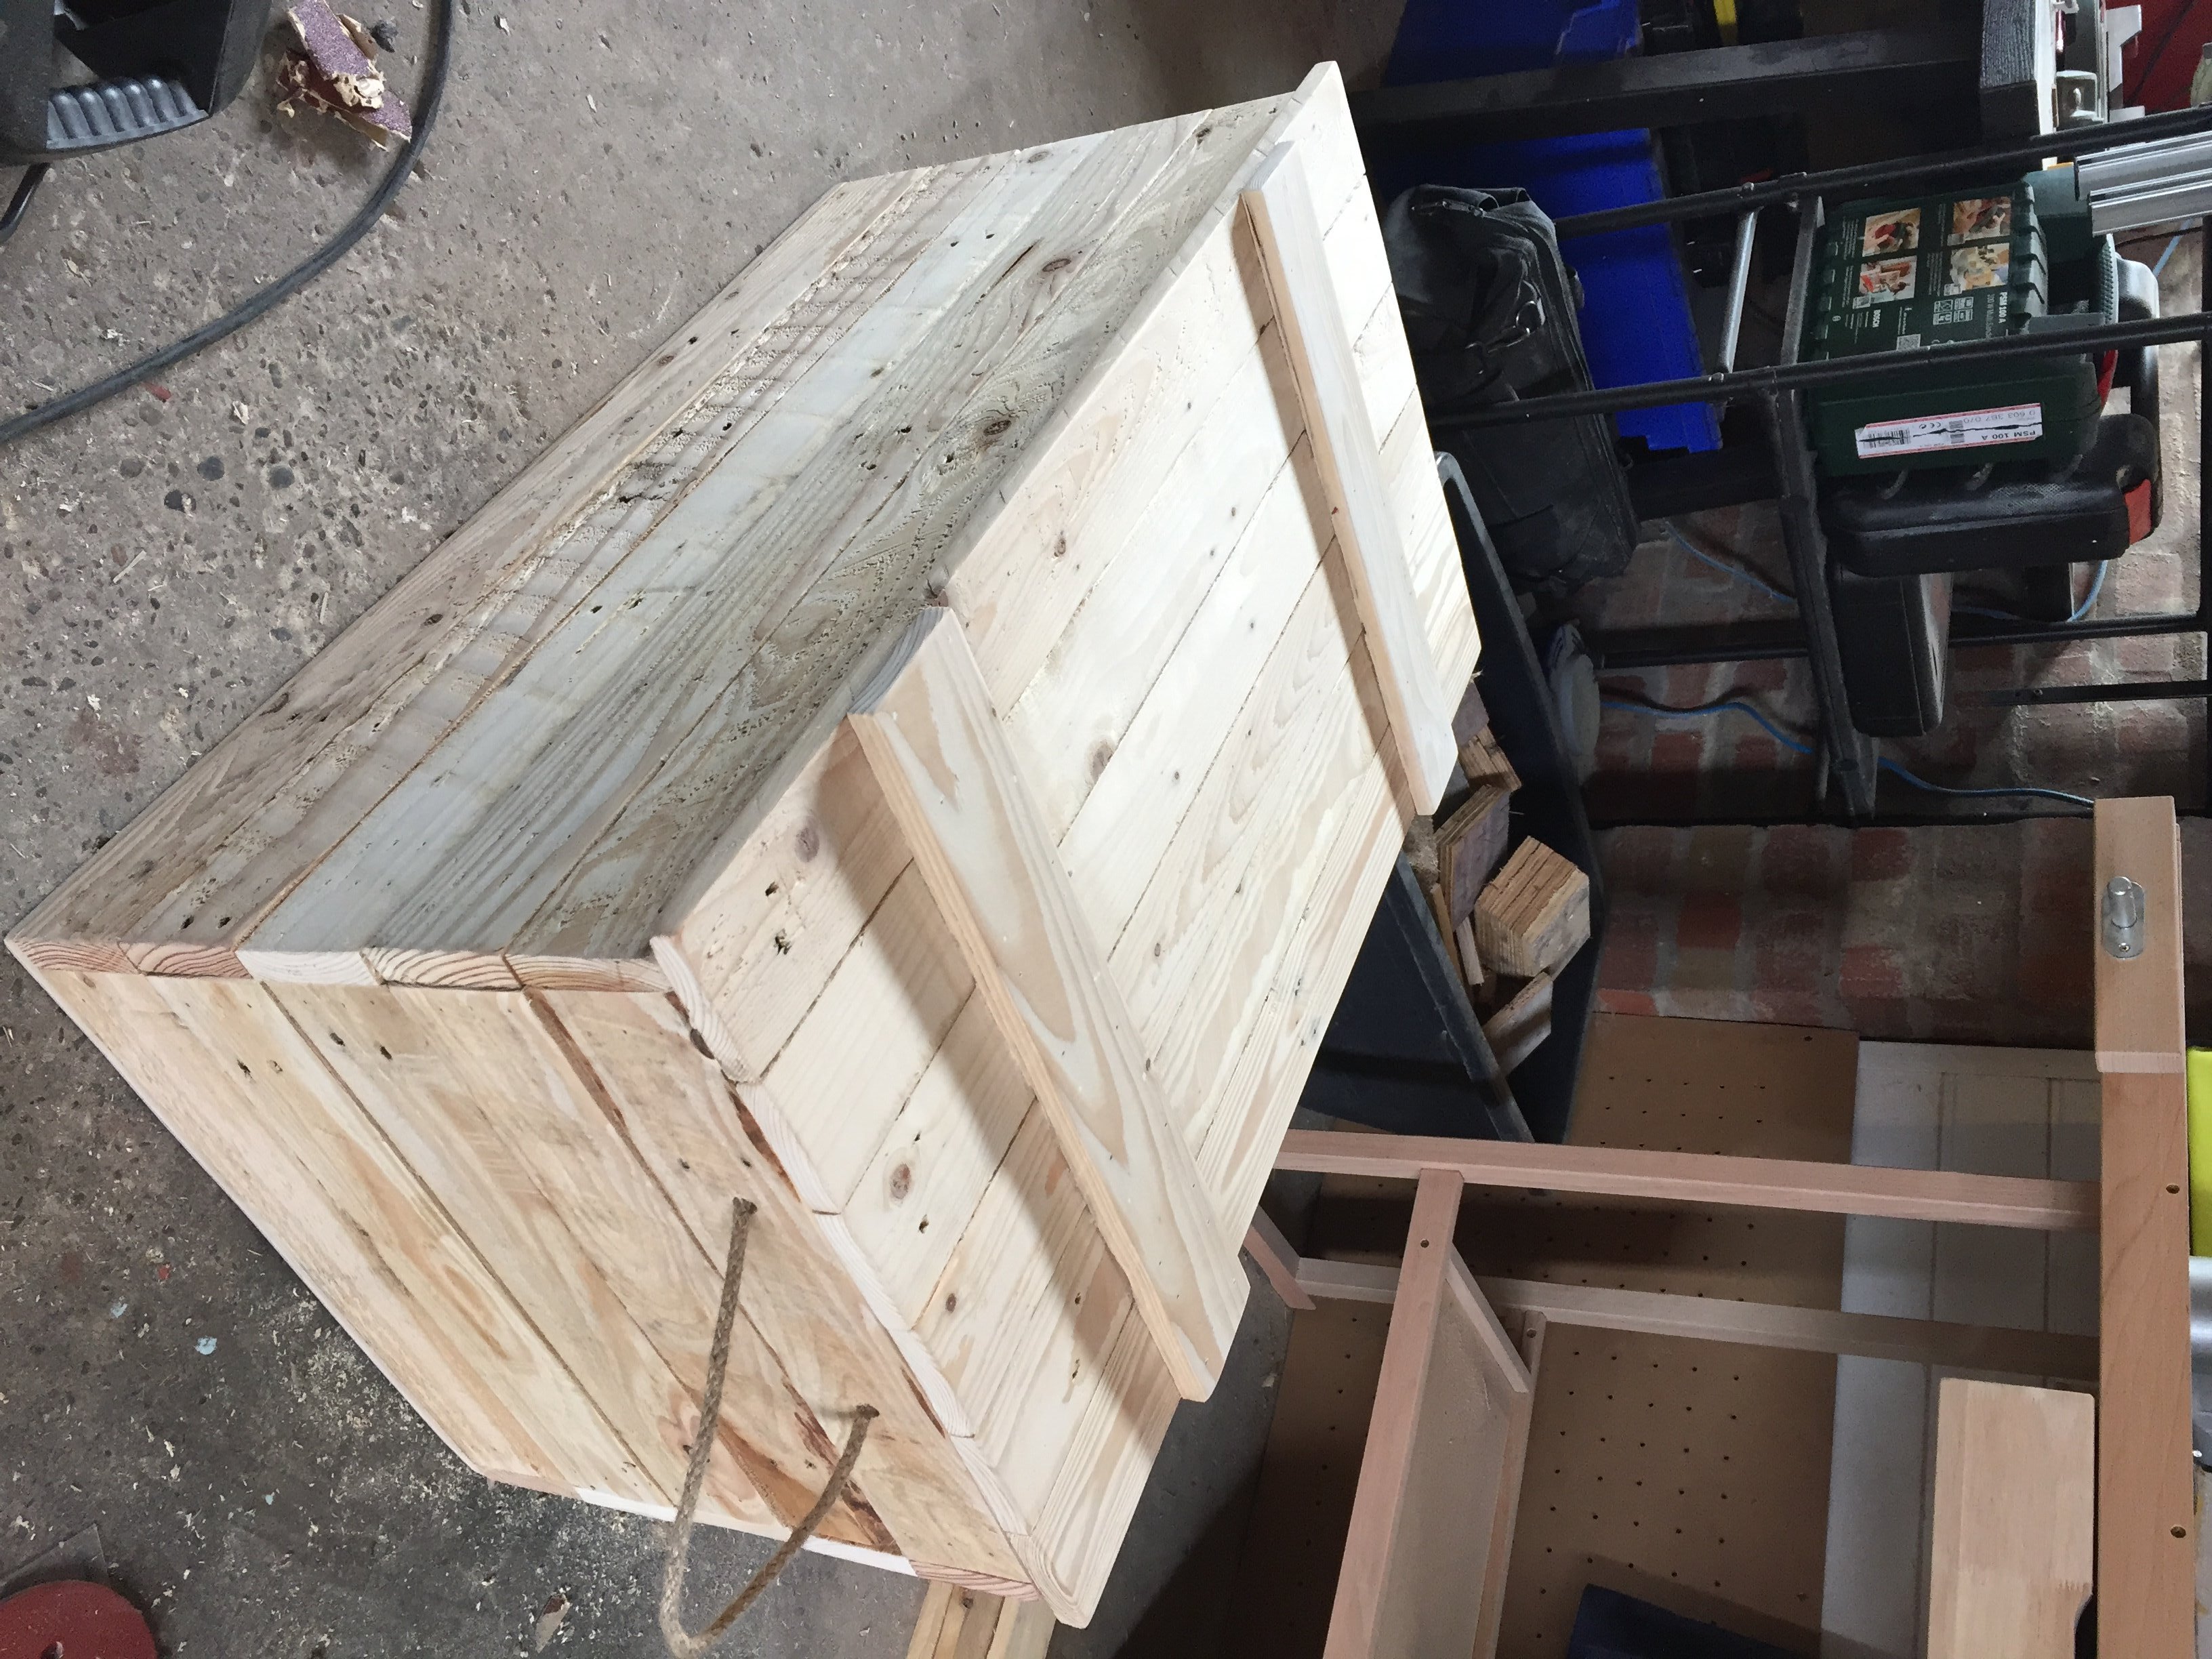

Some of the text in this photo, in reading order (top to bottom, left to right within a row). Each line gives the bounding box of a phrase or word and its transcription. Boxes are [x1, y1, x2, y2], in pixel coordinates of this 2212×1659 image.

[1999, 291, 2008, 306] PSM
[1999, 306, 2007, 318] 100
[1872, 309, 1881, 328] BOSCH
[1963, 416, 1982, 424] 070
[2007, 411, 2026, 419] 603
